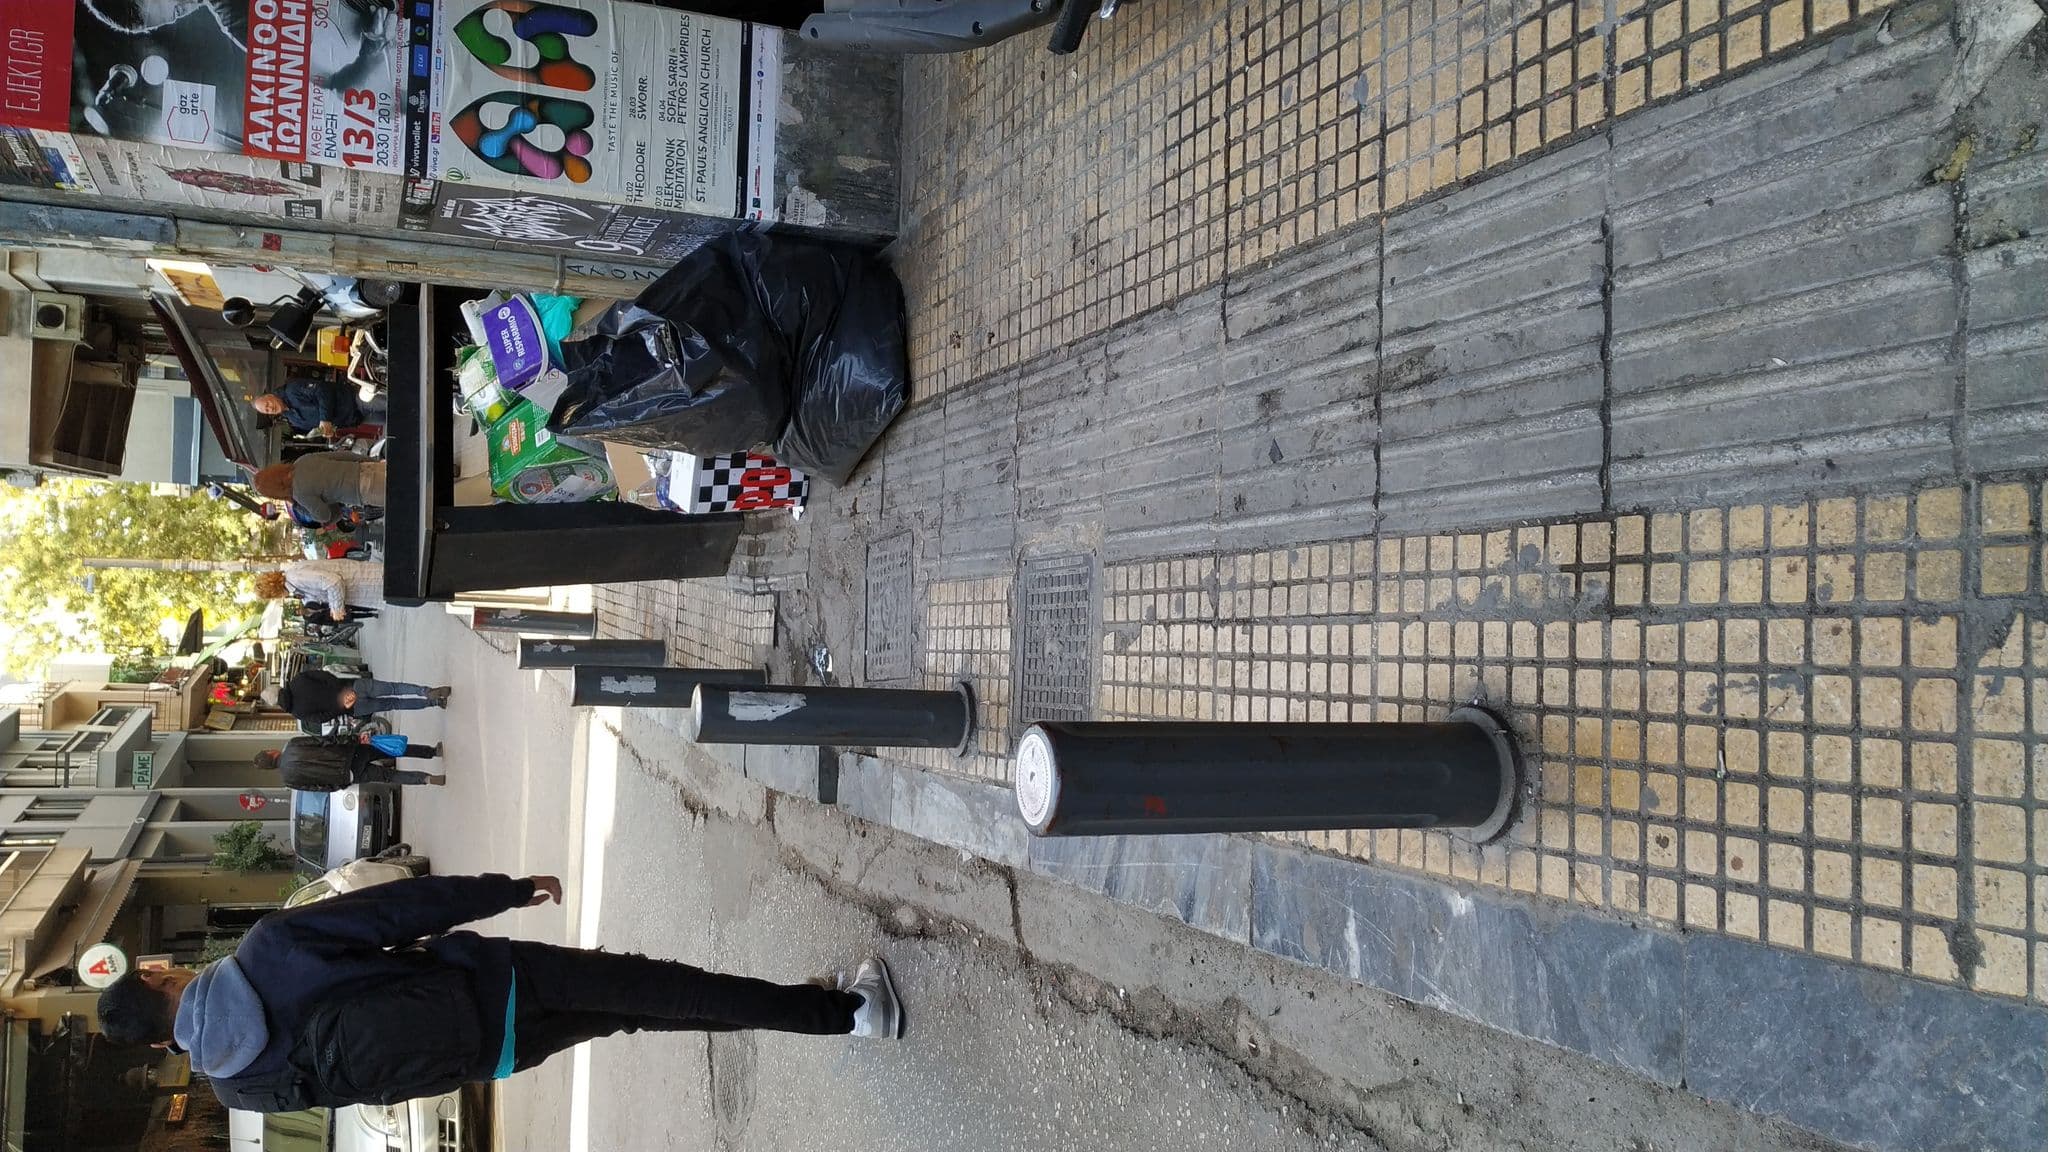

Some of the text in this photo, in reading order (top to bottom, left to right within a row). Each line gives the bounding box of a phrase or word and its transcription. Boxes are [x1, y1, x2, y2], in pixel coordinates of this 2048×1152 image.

[5, 28, 44, 112] EJEKT.GR
[276, 0, 306, 154] ΙΩΑΝΝΙΔΗ
[668, 55, 678, 87] SARRI
[678, 14, 690, 125] PETROS LAMPRIDES
[178, 94, 190, 114] gaz
[189, 93, 200, 116] arte
[310, 74, 326, 157] ΚΑΘΕ ΤΕΤΑΡΤΗ
[377, 92, 392, 124] 2019
[608, 50, 619, 152] TASTE THE MUSIC OF
[638, 74, 648, 120] SWORR.
[658, 100, 666, 122] 04.04
[667, 88, 677, 123] SOFIA
[696, 28, 712, 203] ST. PAUL'S ANGLICAN CHURCH
[325, 113, 338, 159] ΕΝΑΡΞΗ
[342, 87, 376, 168] 13/3
[376, 133, 390, 167] 20:30
[432, 146, 440, 172] viva.gr
[626, 182, 634, 202] 21.02
[634, 140, 646, 204] THEODORE
[664, 138, 675, 208] ELEKTRONIK
[674, 139, 686, 209] MEDITATION
[655, 186, 664, 207] 07.03
[620, 216, 663, 245] MARCH
[500, 328, 514, 354] SUPER
[508, 316, 526, 357] RISPARMIO
